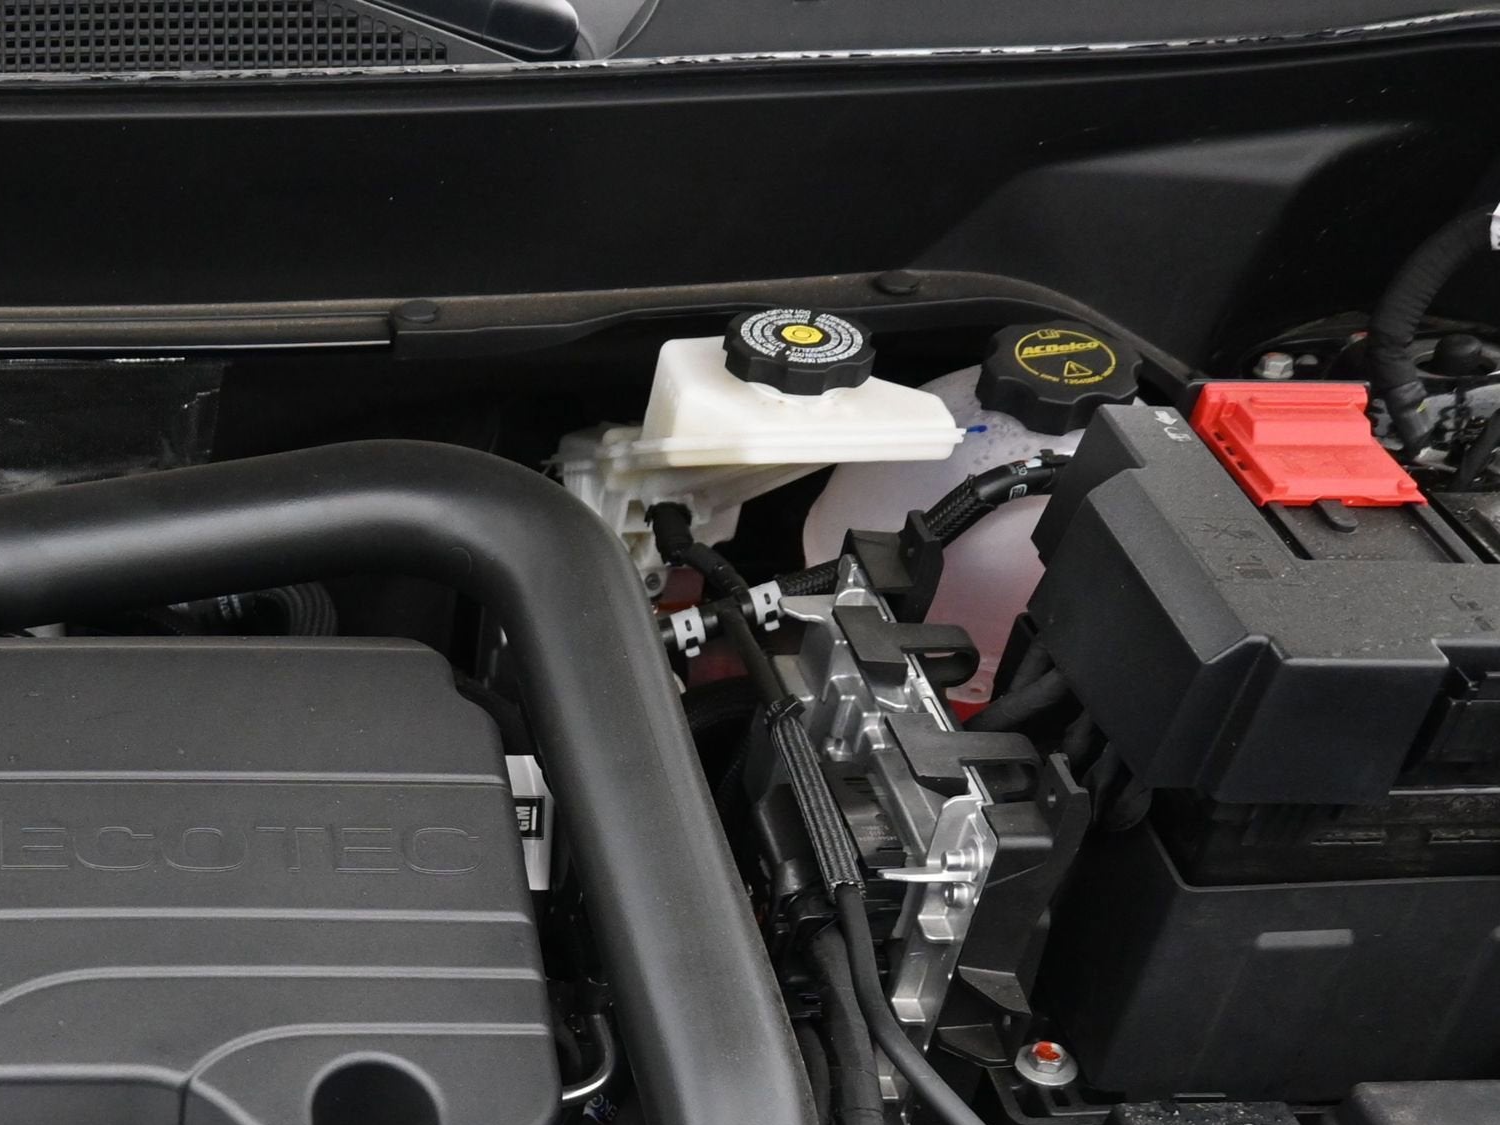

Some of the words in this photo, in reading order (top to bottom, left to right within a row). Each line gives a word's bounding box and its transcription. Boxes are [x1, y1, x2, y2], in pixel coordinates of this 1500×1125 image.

[1022, 340, 1100, 357] ACDelco
[515, 806, 531, 831] GM
[0, 820, 485, 876] ECOTEC
